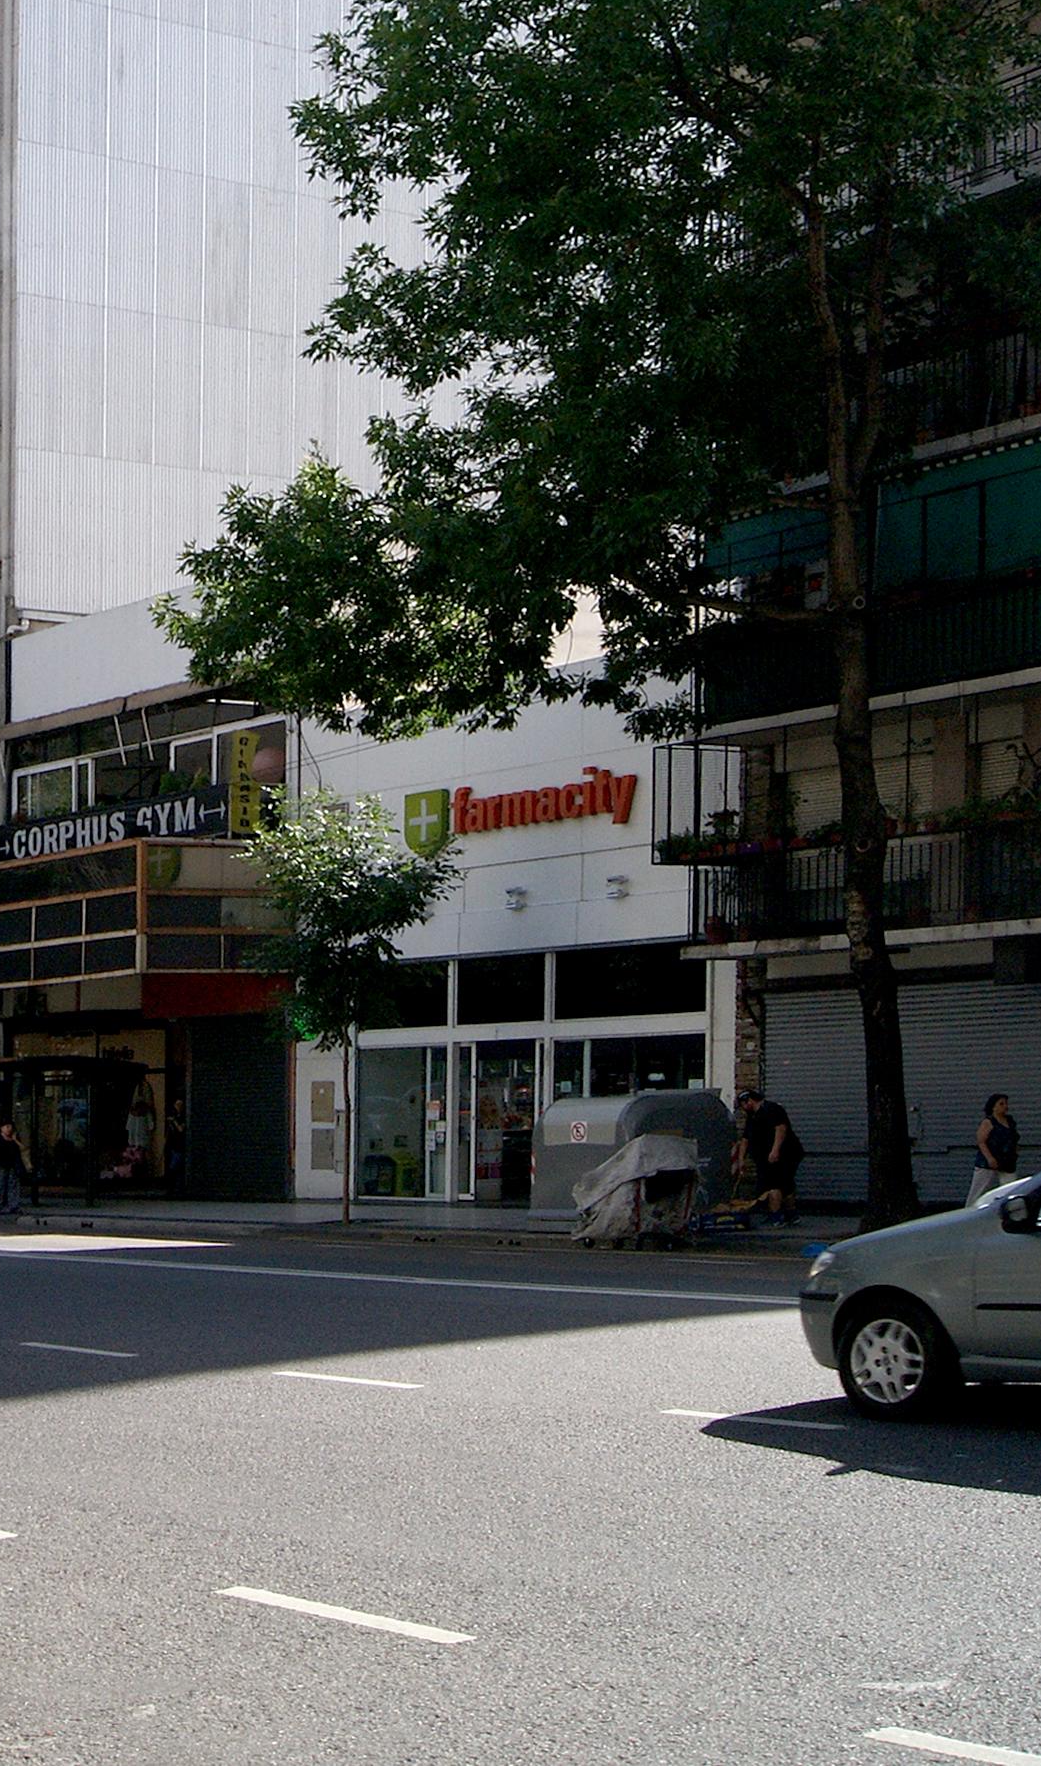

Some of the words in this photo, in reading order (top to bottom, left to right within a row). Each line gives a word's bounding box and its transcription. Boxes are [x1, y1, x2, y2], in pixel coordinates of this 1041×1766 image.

[13, 811, 126, 859] CORPHUS
[136, 796, 196, 836] GYM
[451, 766, 637, 834] farmacity
